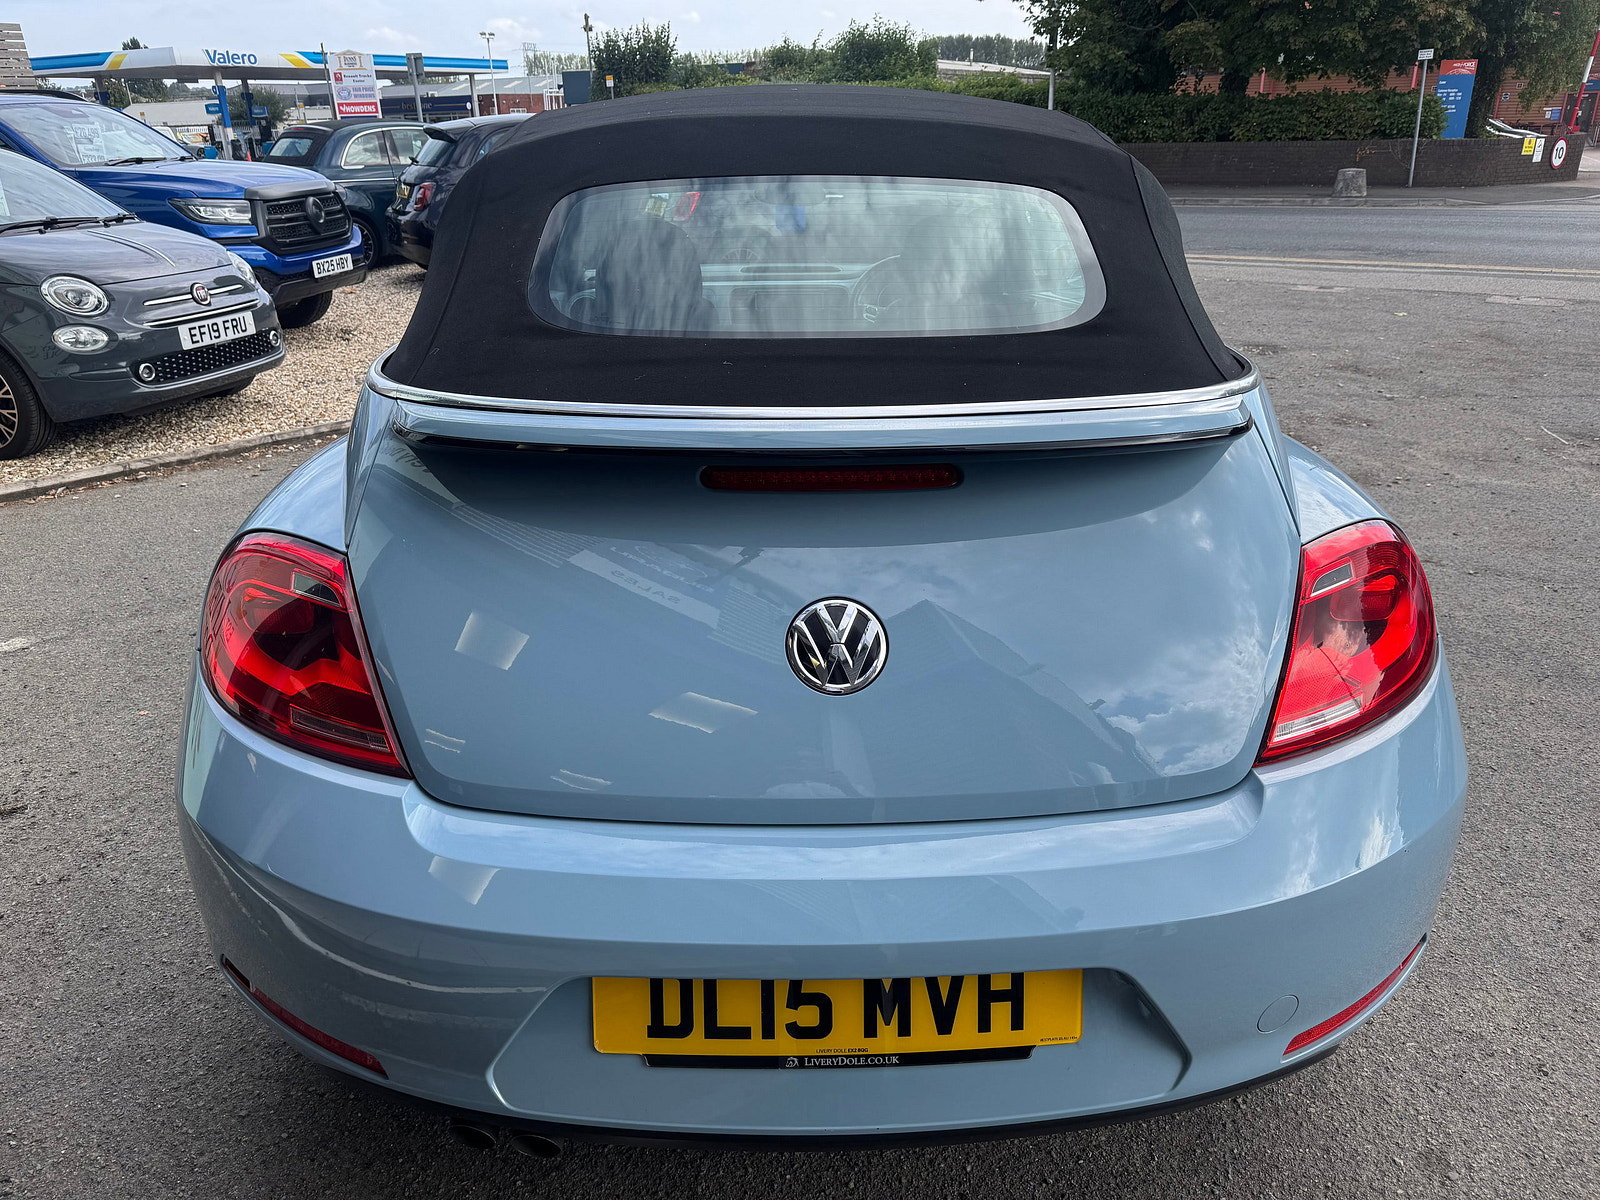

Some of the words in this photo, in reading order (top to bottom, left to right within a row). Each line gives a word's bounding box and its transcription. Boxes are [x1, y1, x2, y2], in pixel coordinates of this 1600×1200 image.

[205, 49, 258, 65] Valero
[347, 105, 376, 113] HOWDENS
[1554, 146, 1565, 160] 10
[316, 259, 335, 274] BX25
[335, 256, 350, 270] HBY
[188, 321, 222, 345] EF19
[222, 316, 248, 338] FRU
[647, 978, 833, 1040] DL15
[863, 973, 1025, 1038] MVH
